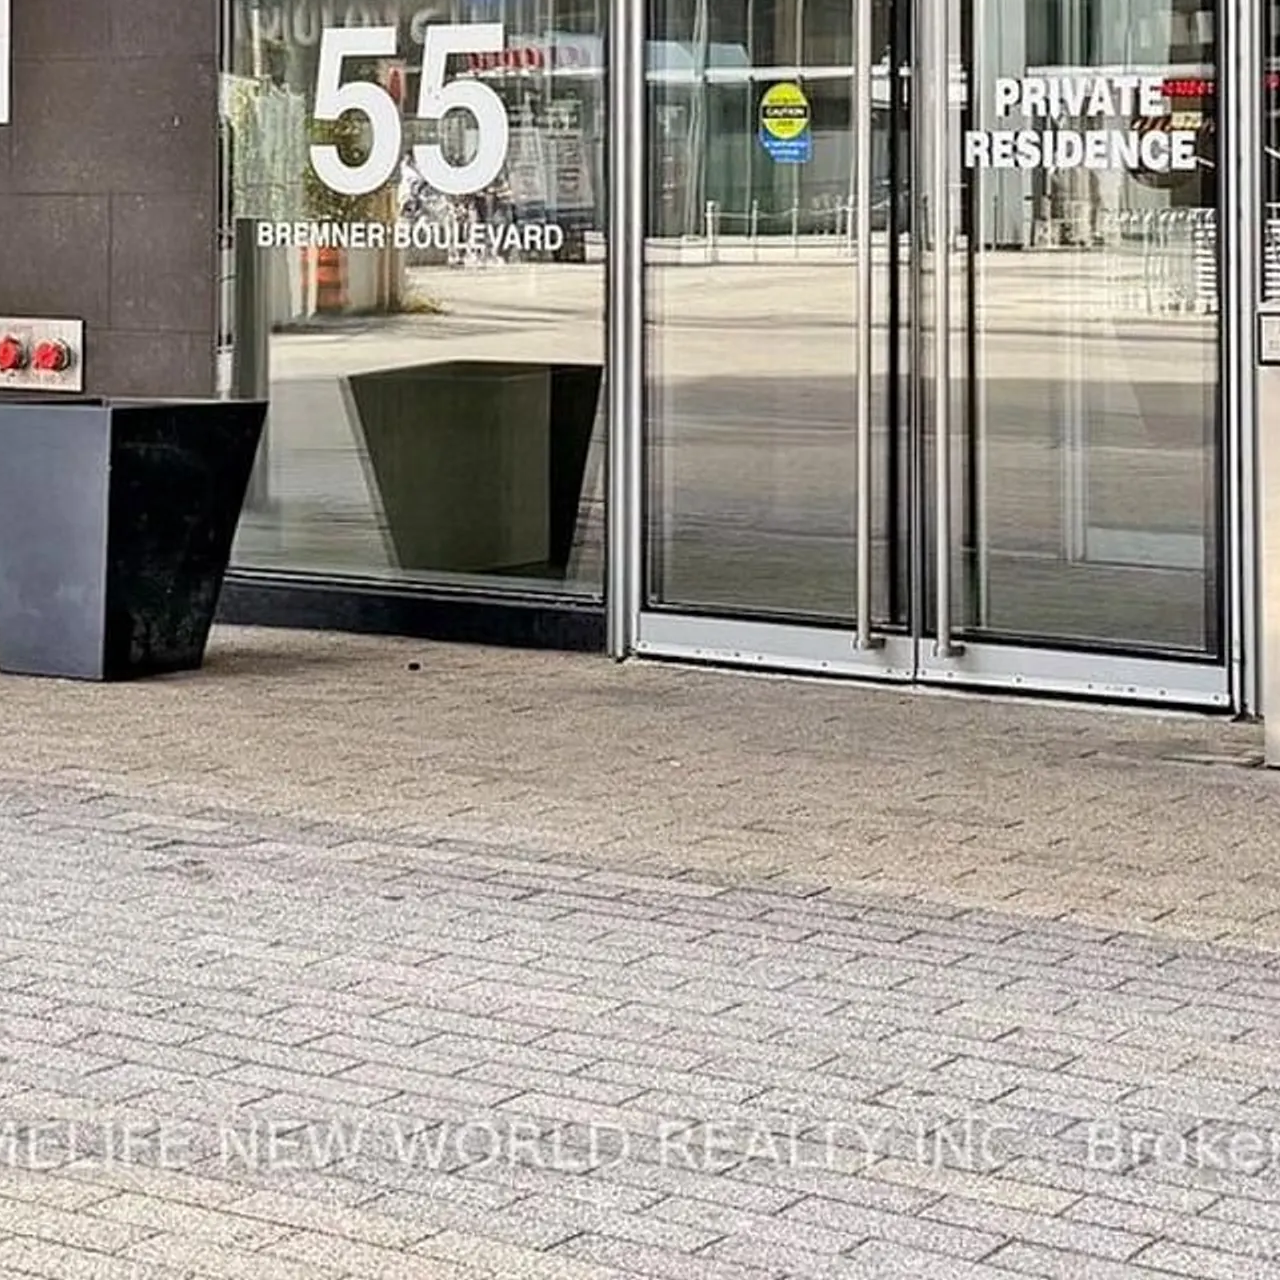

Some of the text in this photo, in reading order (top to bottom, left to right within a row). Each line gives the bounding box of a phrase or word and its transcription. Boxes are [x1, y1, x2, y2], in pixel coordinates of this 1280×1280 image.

[310, 23, 509, 196] 55
[995, 76, 1171, 119] PRIVATE
[964, 130, 1198, 172] RESIDENCE
[256, 221, 564, 250] BREMNER BOULEVARD
